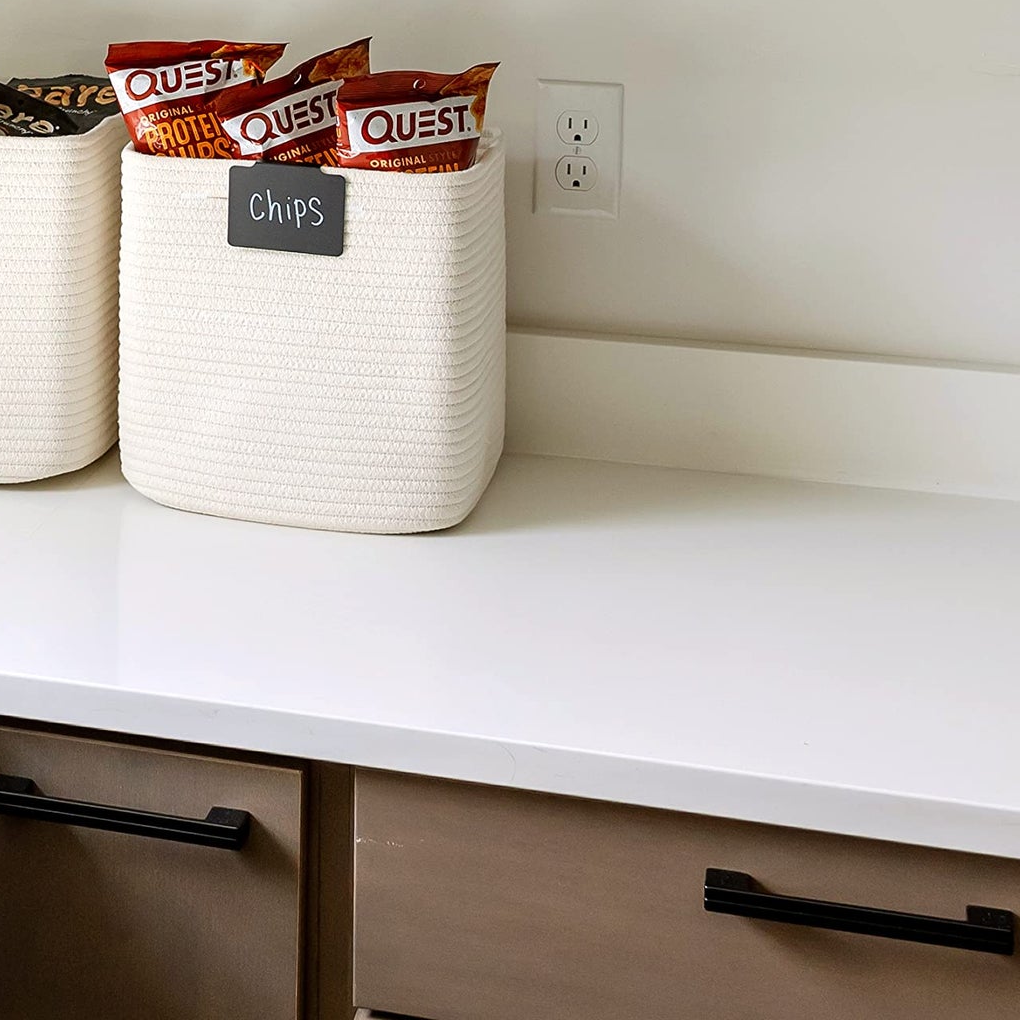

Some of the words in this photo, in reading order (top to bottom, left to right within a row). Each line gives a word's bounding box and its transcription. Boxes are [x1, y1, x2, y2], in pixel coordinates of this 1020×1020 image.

[124, 59, 235, 101] QUEST
[139, 105, 194, 124] ORIGINAL
[145, 112, 221, 153] PROTEI
[240, 89, 337, 146] QUEST
[360, 104, 469, 145] QUEST
[370, 154, 427, 168] ORIGINAL
[428, 150, 459, 161] STYLE
[249, 188, 324, 229] Chips
